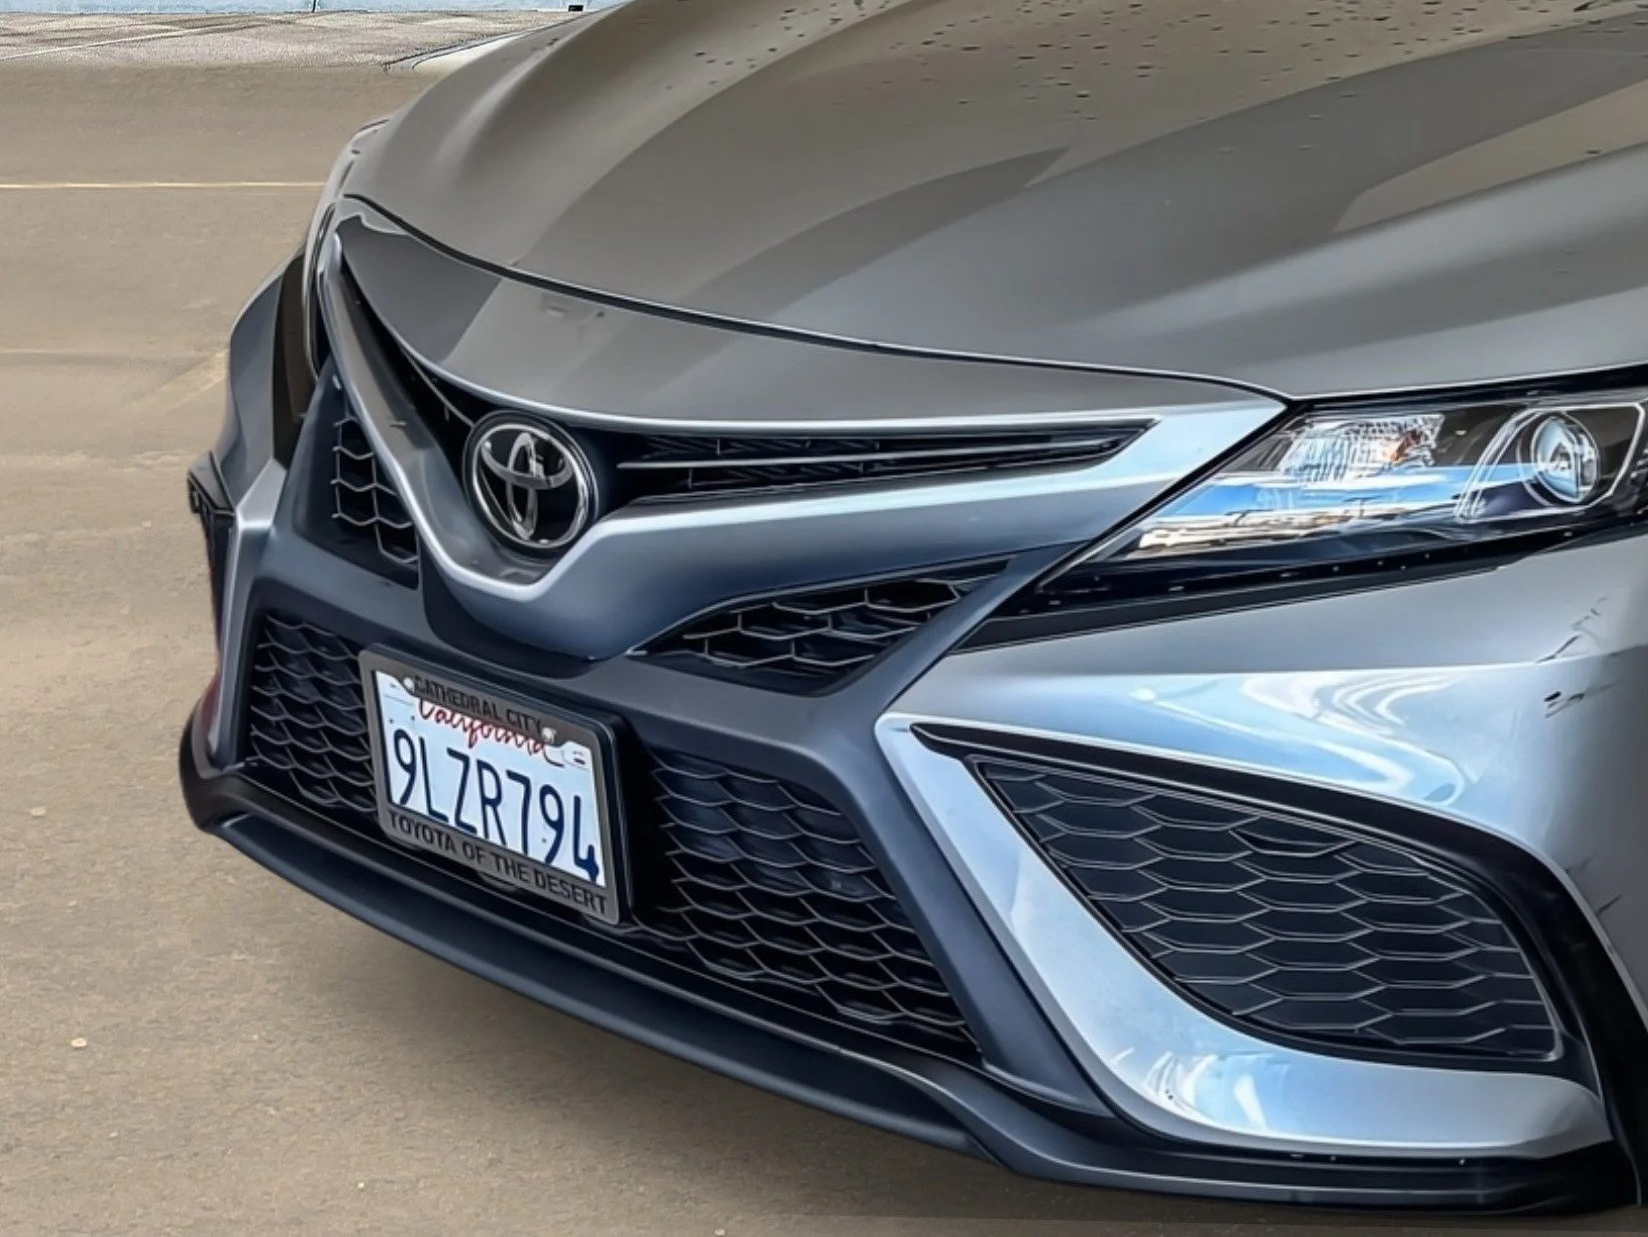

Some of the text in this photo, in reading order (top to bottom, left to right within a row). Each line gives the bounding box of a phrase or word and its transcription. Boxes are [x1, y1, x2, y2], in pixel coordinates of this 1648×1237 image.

[414, 676, 542, 734] CATHEDRAL CITY
[393, 728, 600, 882] 9LZR794
[389, 811, 608, 915] TOYOTA OF THE DESERT
